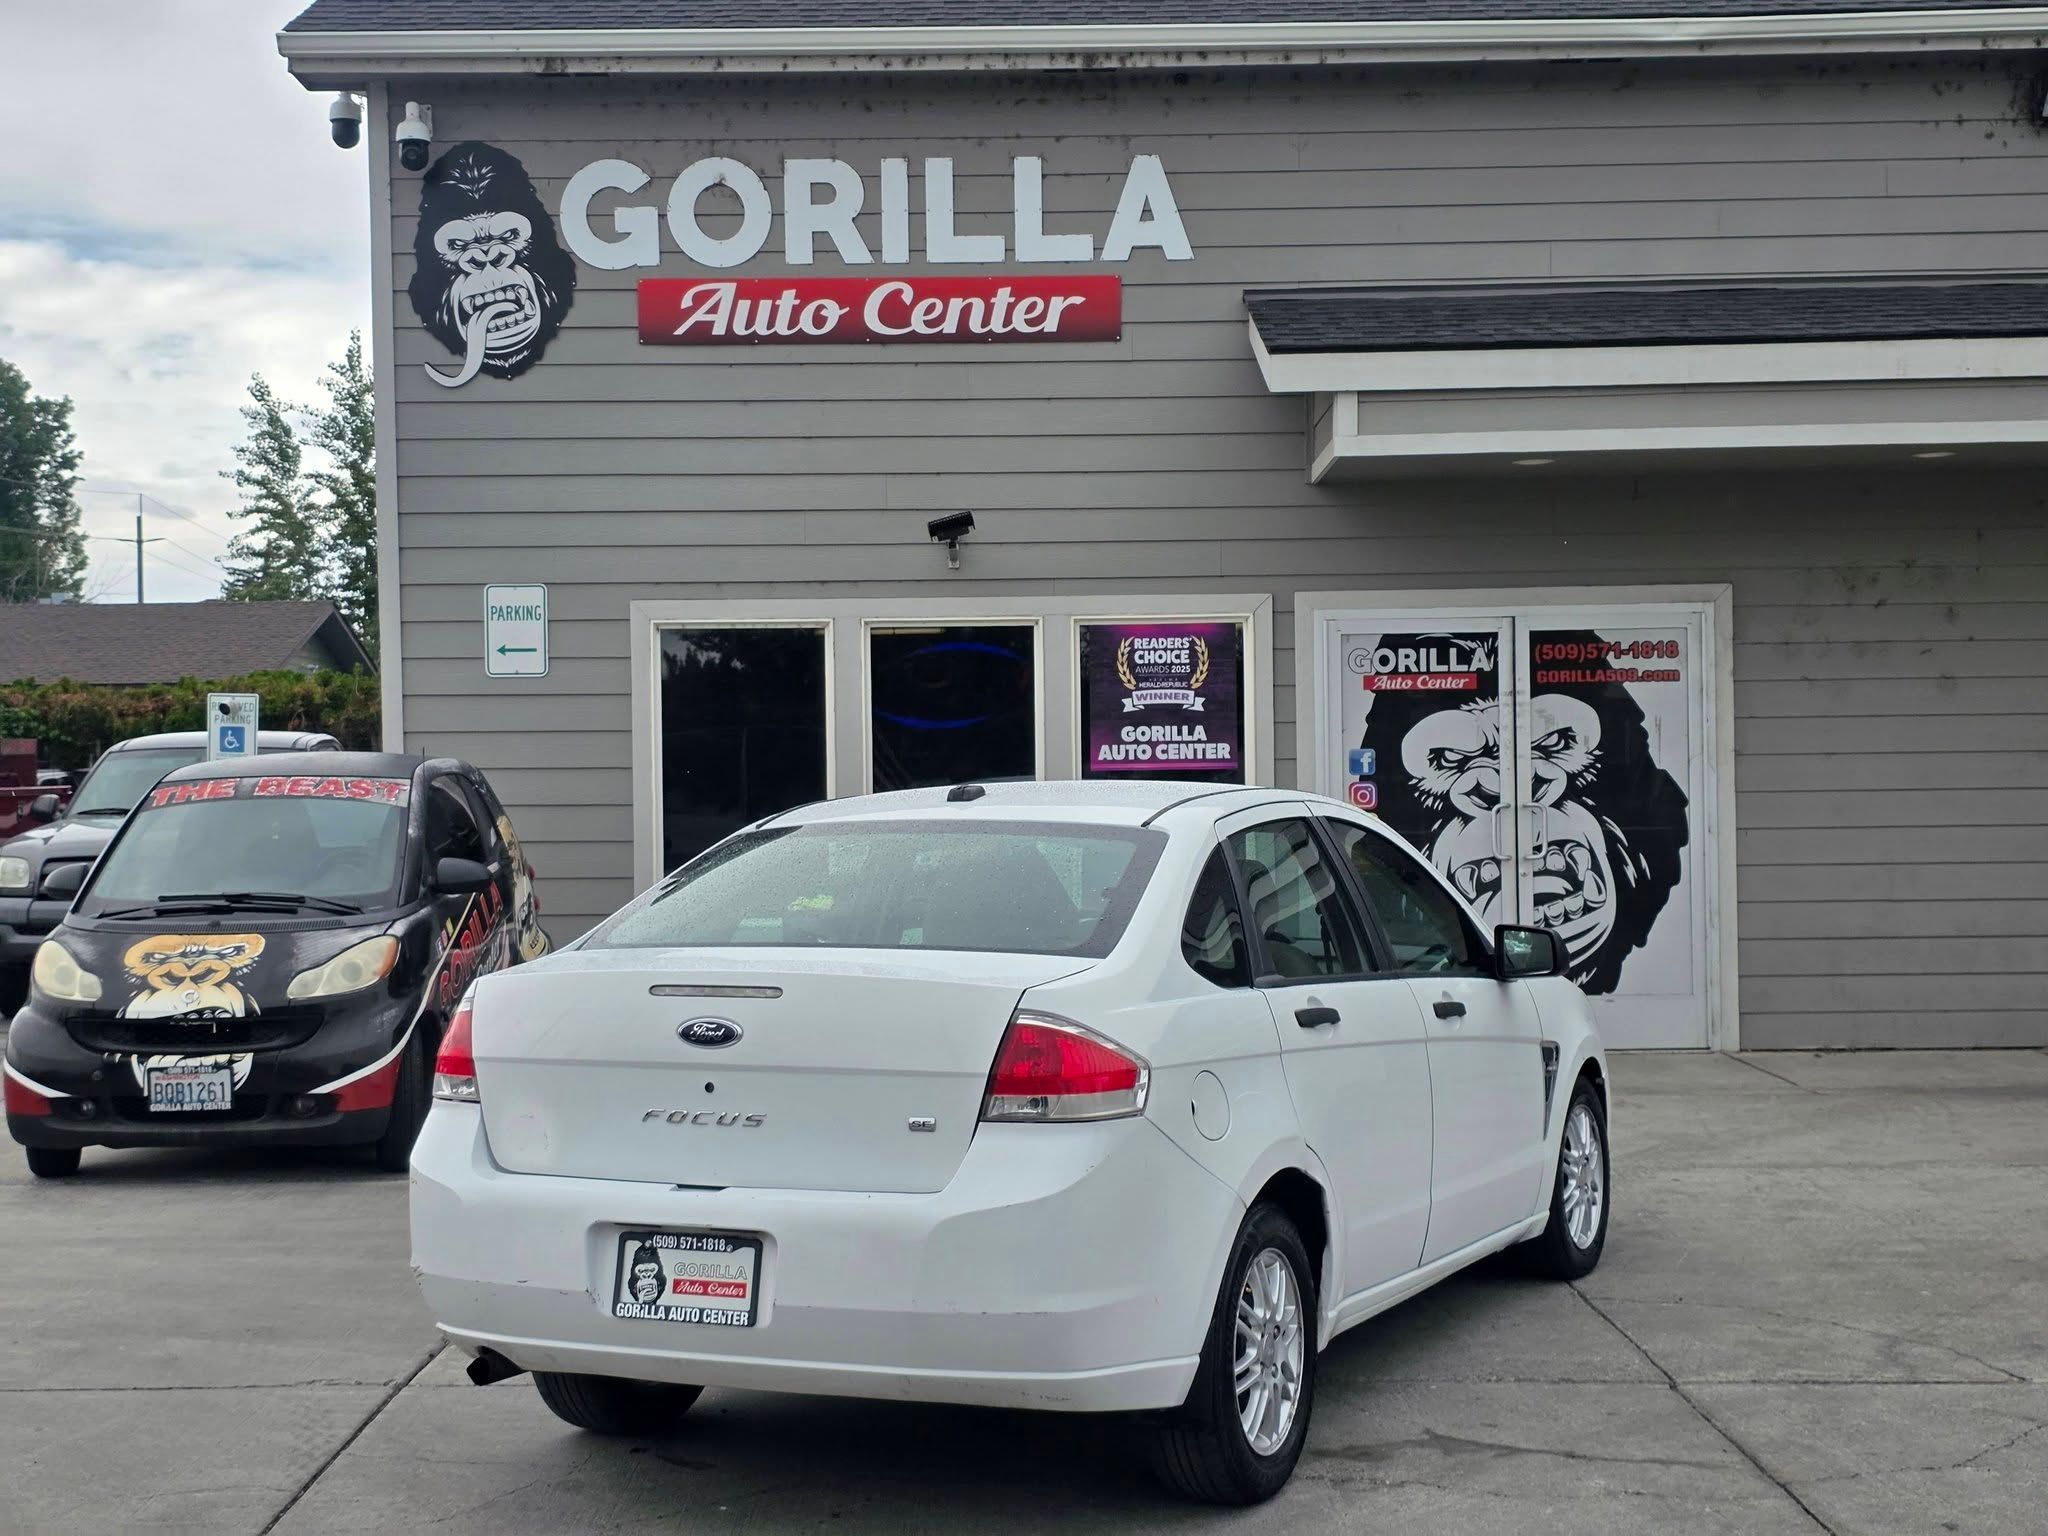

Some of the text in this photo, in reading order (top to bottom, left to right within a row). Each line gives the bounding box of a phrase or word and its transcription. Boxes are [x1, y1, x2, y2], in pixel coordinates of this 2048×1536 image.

[559, 155, 1195, 269] GORILLA
[673, 280, 1087, 337] Auto Center
[490, 605, 542, 621] PARKING
[1134, 637, 1192, 649] READERS'
[1535, 640, 1680, 663] (509)571-1818
[1134, 649, 1190, 664] CHOICE
[1348, 647, 1491, 674] GORILLA
[1135, 665, 1191, 674] AWARDS 2025
[1536, 668, 1681, 684] GORILLA509.com
[1373, 675, 1470, 689] Auto Center
[1135, 692, 1190, 702] WINNER
[214, 714, 252, 725] PARKING
[1121, 725, 1207, 742] GORILLA
[1098, 743, 1231, 760] AUTO CENTER
[150, 776, 409, 807] THE BEAST
[690, 1022, 725, 1041] Ford
[182, 1102, 202, 1111] AUTO
[642, 1108, 768, 1128] FOCUS
[653, 1235, 726, 1252] (509) 571-1818
[674, 1261, 748, 1280] GORILLA
[675, 1279, 745, 1297] Auto Center
[668, 1306, 700, 1323] AUTO
[702, 1309, 749, 1326] CENTER
